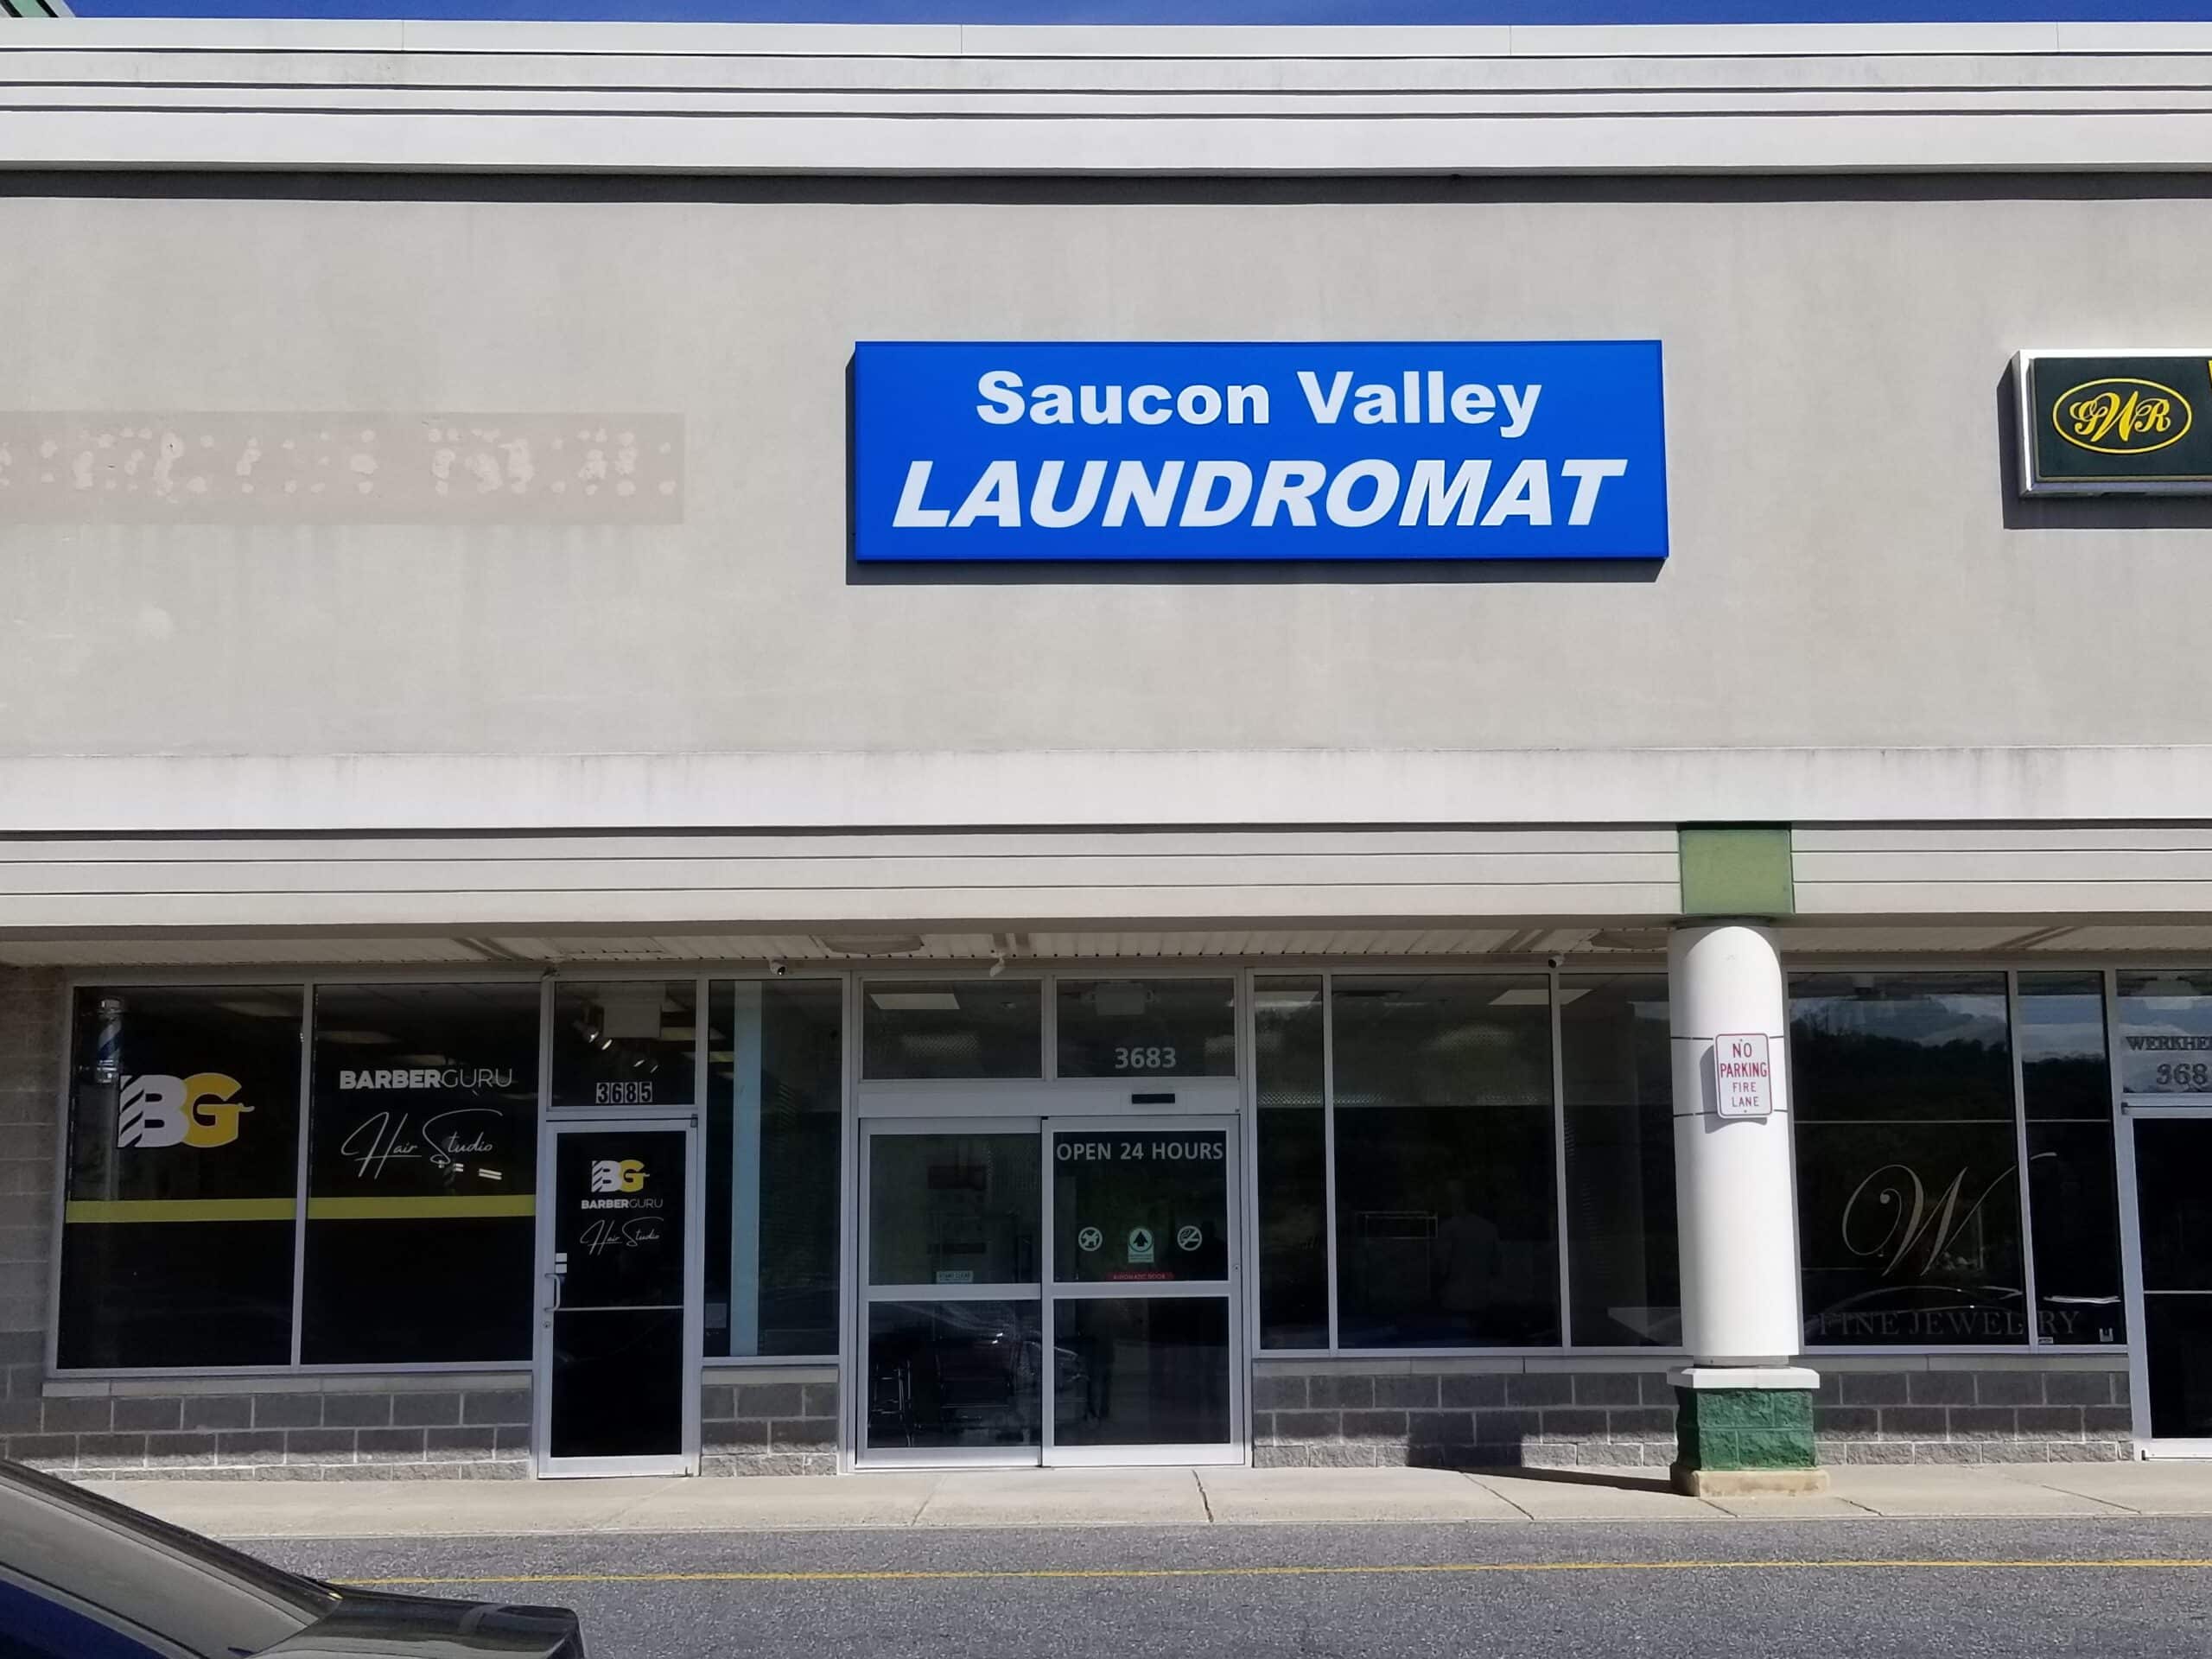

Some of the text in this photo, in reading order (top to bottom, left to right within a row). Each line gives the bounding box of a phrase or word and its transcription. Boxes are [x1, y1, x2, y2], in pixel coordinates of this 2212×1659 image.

[976, 370, 1542, 438] Saucon Valley
[893, 458, 1628, 528] LAUNDROMAT
[1732, 1043, 1752, 1058] NO
[2126, 1036, 2212, 1051] WERKHE
[1115, 1047, 1177, 1069] 3683
[340, 1068, 513, 1090] BARBERGURU
[1719, 1062, 1768, 1078] PARKING
[596, 1083, 652, 1103] 3685
[1732, 1082, 1757, 1093] FIRE
[117, 1072, 255, 1147] BG
[1732, 1096, 1760, 1108] LANE
[340, 1108, 504, 1180] Hair Studio
[1056, 1141, 1224, 1161] OPEN 24 HOURS
[591, 1160, 651, 1193] BG
[581, 1198, 664, 1211] BARBERGURU
[1842, 1152, 2058, 1277] W
[580, 1216, 664, 1256] Hair Studio
[1819, 1312, 1900, 1335] FINE
